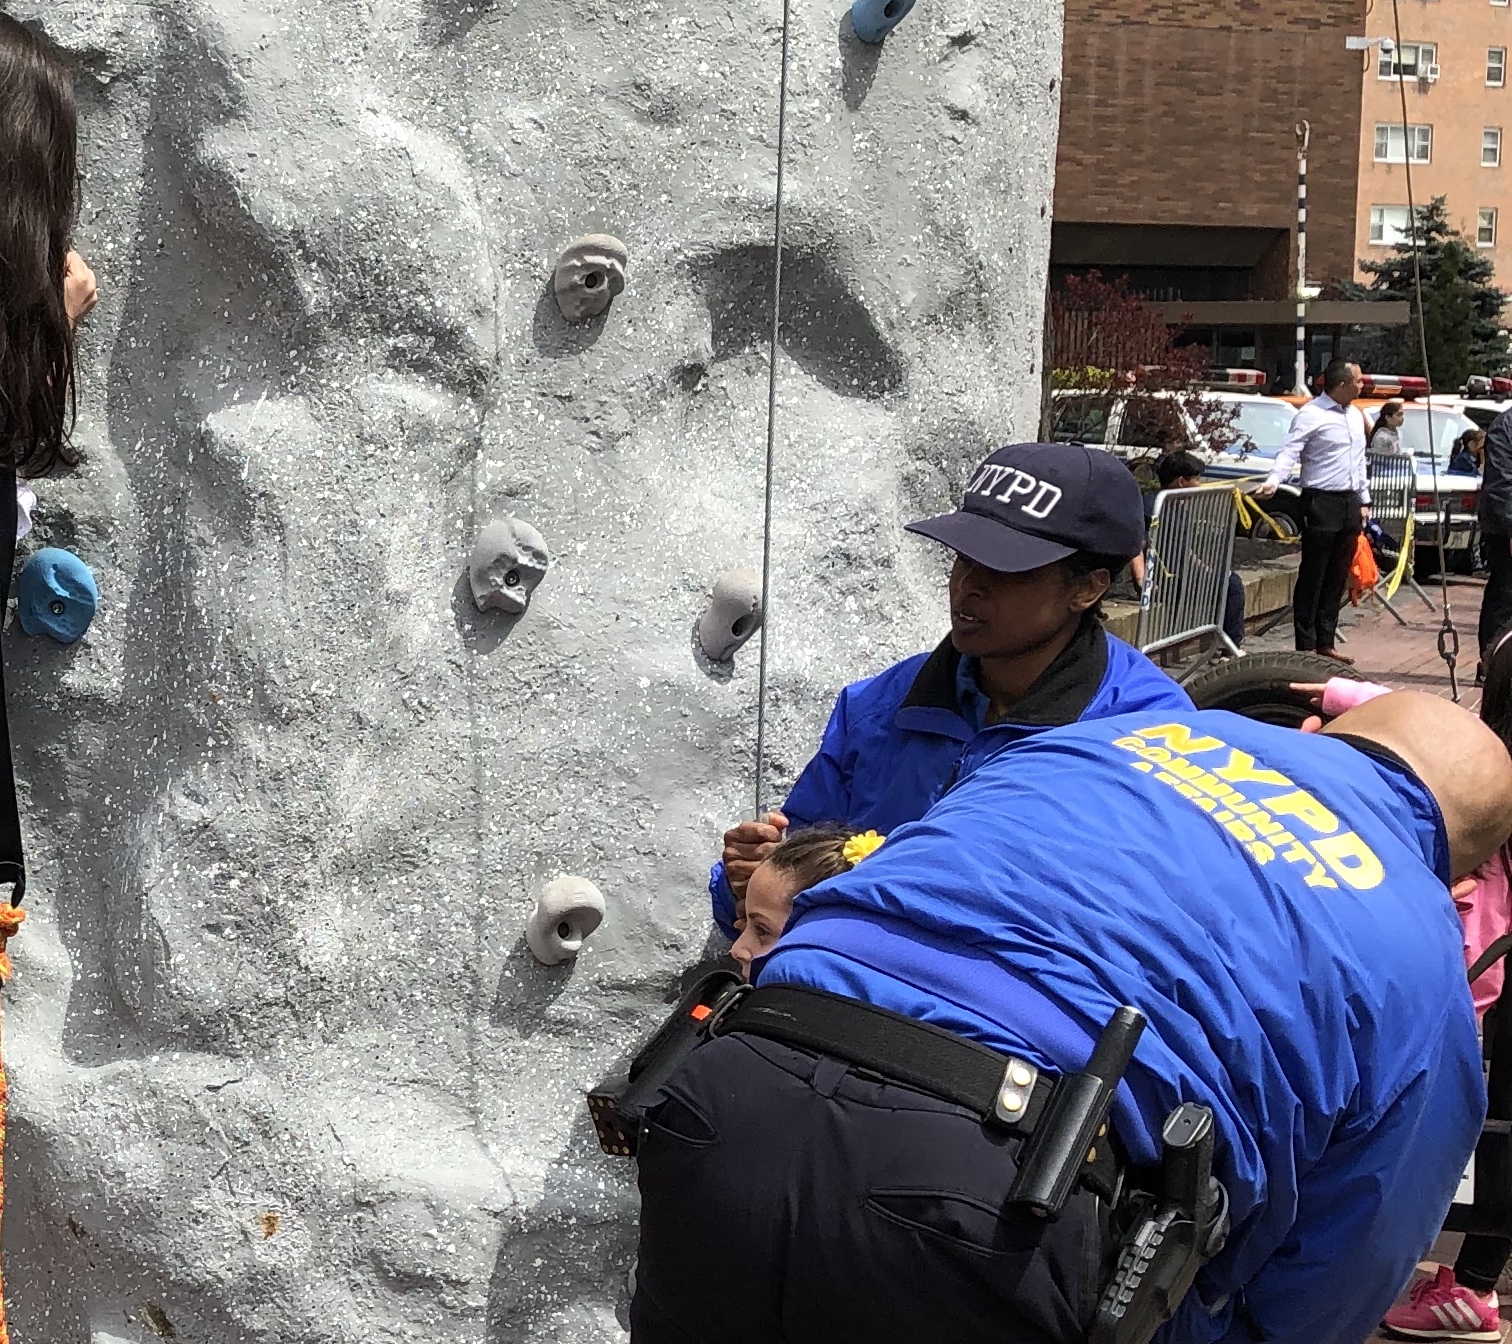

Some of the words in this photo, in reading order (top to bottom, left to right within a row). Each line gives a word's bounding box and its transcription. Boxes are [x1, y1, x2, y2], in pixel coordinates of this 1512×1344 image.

[966, 464, 1063, 519] NYPD
[1112, 736, 1338, 889] COMMUNITY
[1129, 761, 1276, 866] AFFAIRS
[1132, 722, 1386, 890] NYPD
